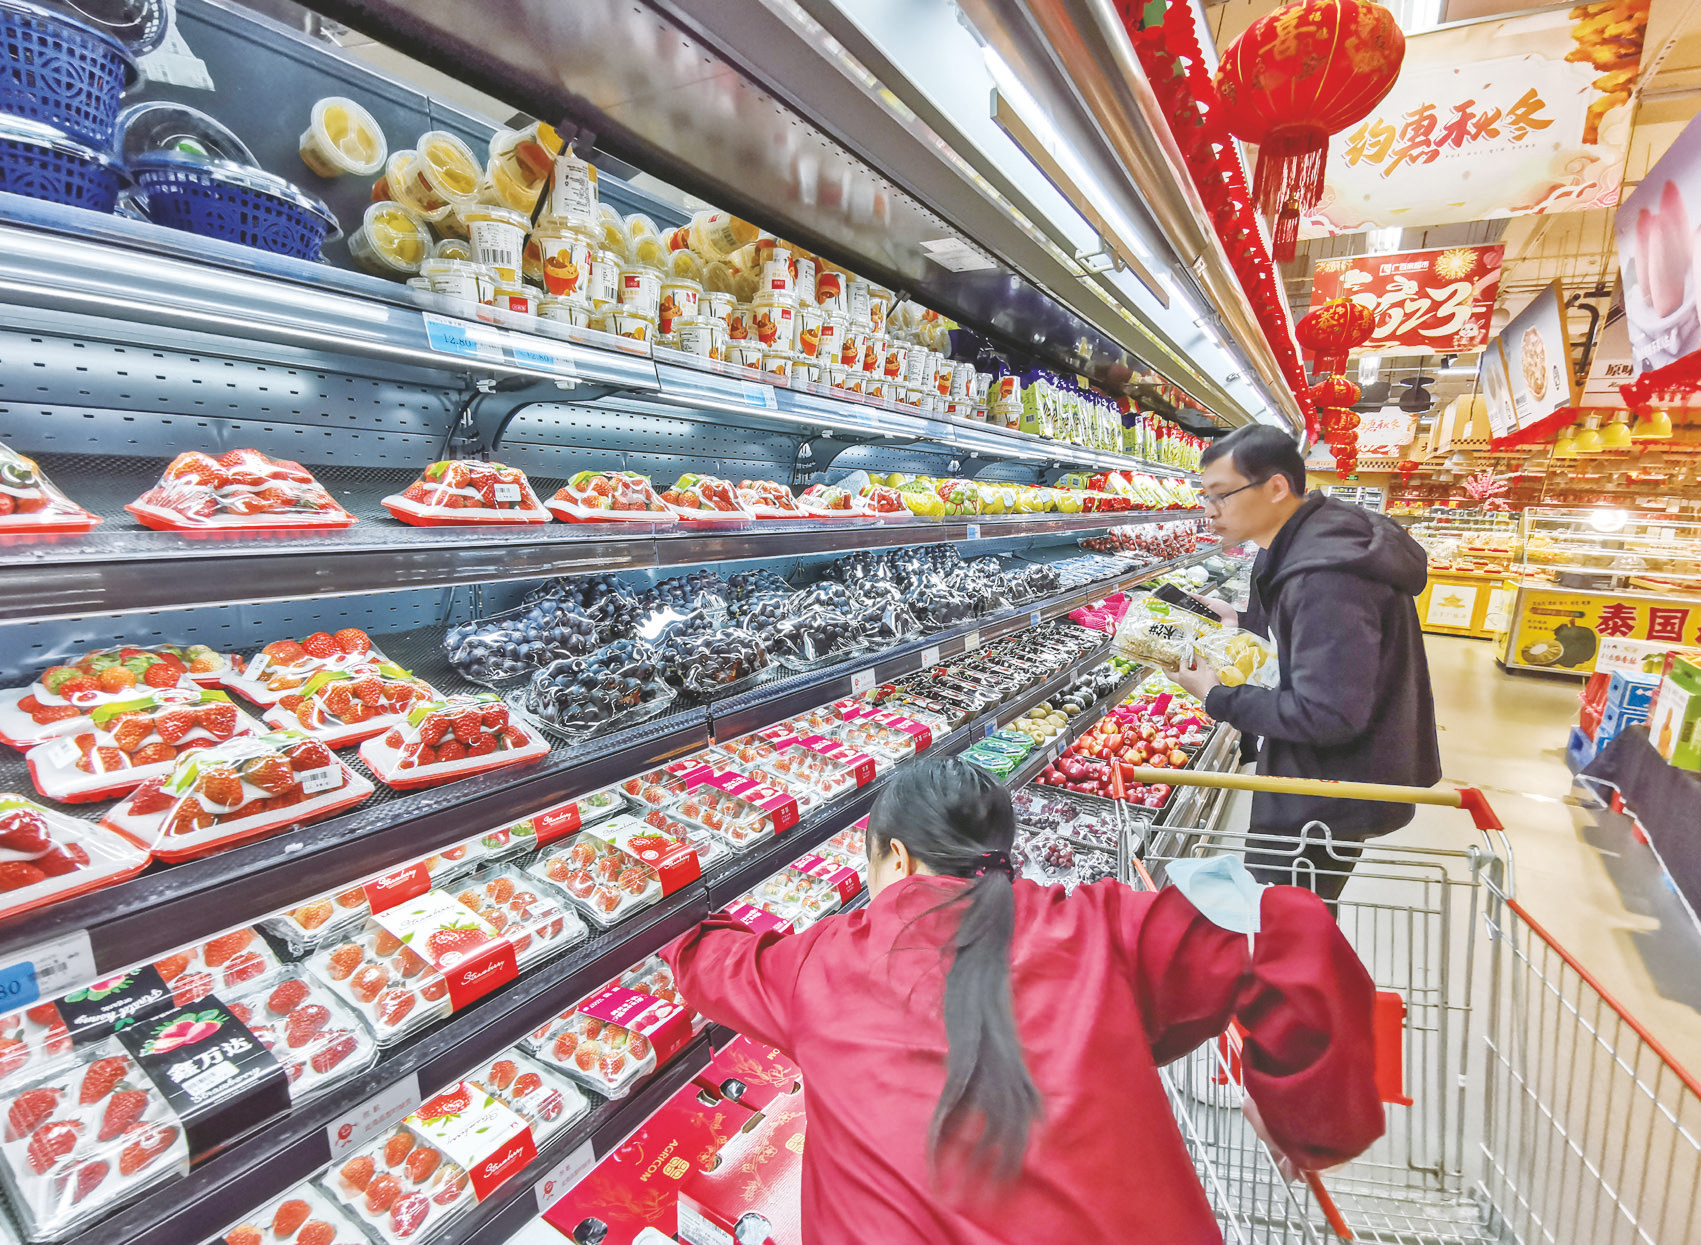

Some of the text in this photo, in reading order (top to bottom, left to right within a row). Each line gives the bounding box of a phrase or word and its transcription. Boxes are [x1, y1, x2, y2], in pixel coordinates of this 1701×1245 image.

[1341, 87, 1556, 178] 约惠秋冬
[443, 333, 472, 348] 12.80
[1594, 602, 1701, 644] 泰国
[376, 868, 417, 889] Strawberry
[461, 959, 505, 985] Strawberry
[166, 1036, 254, 1083] 鑫万达
[483, 1144, 524, 1179] Strawberry
[640, 1138, 679, 1182] AGRICOM
